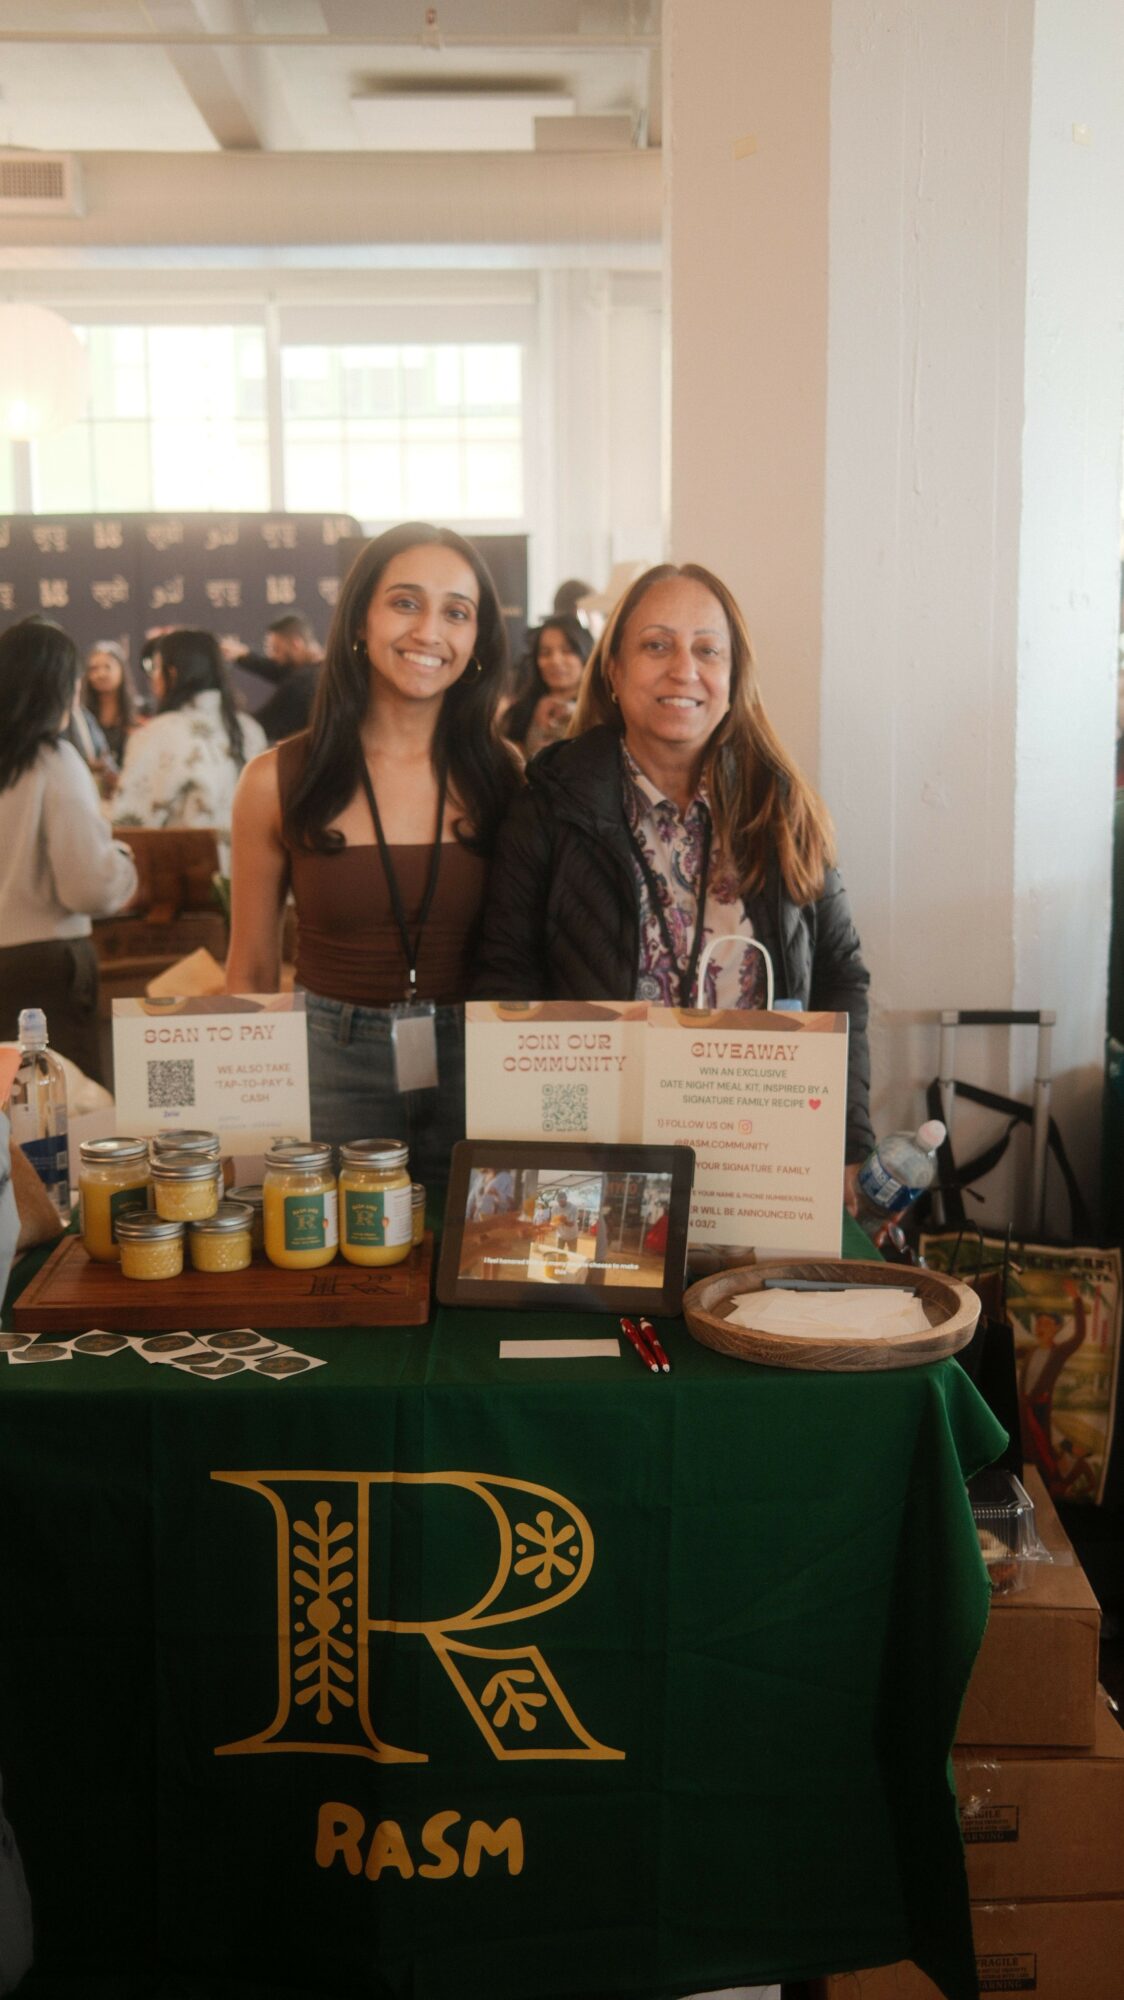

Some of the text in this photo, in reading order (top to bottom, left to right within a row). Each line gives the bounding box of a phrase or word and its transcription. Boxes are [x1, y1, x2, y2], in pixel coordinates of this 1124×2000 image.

[144, 1024, 275, 1044] SCAN TO PAY
[518, 1034, 612, 1050] JOIN OUR
[691, 1041, 800, 1061] GIVEAWAY
[217, 1063, 291, 1075] WE ALSO TAKE
[503, 1056, 627, 1072] COMMUNITY
[699, 1067, 788, 1078] WIN AN EXCLUSIVE
[286, 1078, 294, 1087] &
[660, 1079, 684, 1088] DATE
[686, 1080, 714, 1090] NIGHT
[717, 1082, 742, 1092] MEAL
[763, 1084, 806, 1094] INSPIRED
[808, 1086, 820, 1094] BY
[822, 1086, 829, 1094] A
[241, 1093, 270, 1104] CASH
[682, 1095, 805, 1109] SIGNATURE FAMILY RECIPE
[666, 1119, 704, 1129] FOLLOW
[706, 1120, 718, 1130] US
[720, 1121, 734, 1130] ON
[696, 1162, 810, 1176] YOUR SIGNATURE FAMILY
[701, 1206, 722, 1216] WILL
[724, 1207, 735, 1216] BE
[737, 1208, 796, 1220] ANNOUNCED
[798, 1211, 814, 1220] VIA
[695, 1220, 716, 1228] 03/2
[210, 1470, 626, 1764] R
[315, 1802, 524, 1881] RASM
[963, 1831, 1005, 1841] ARNING
[982, 1981, 1022, 1990] ARNING
